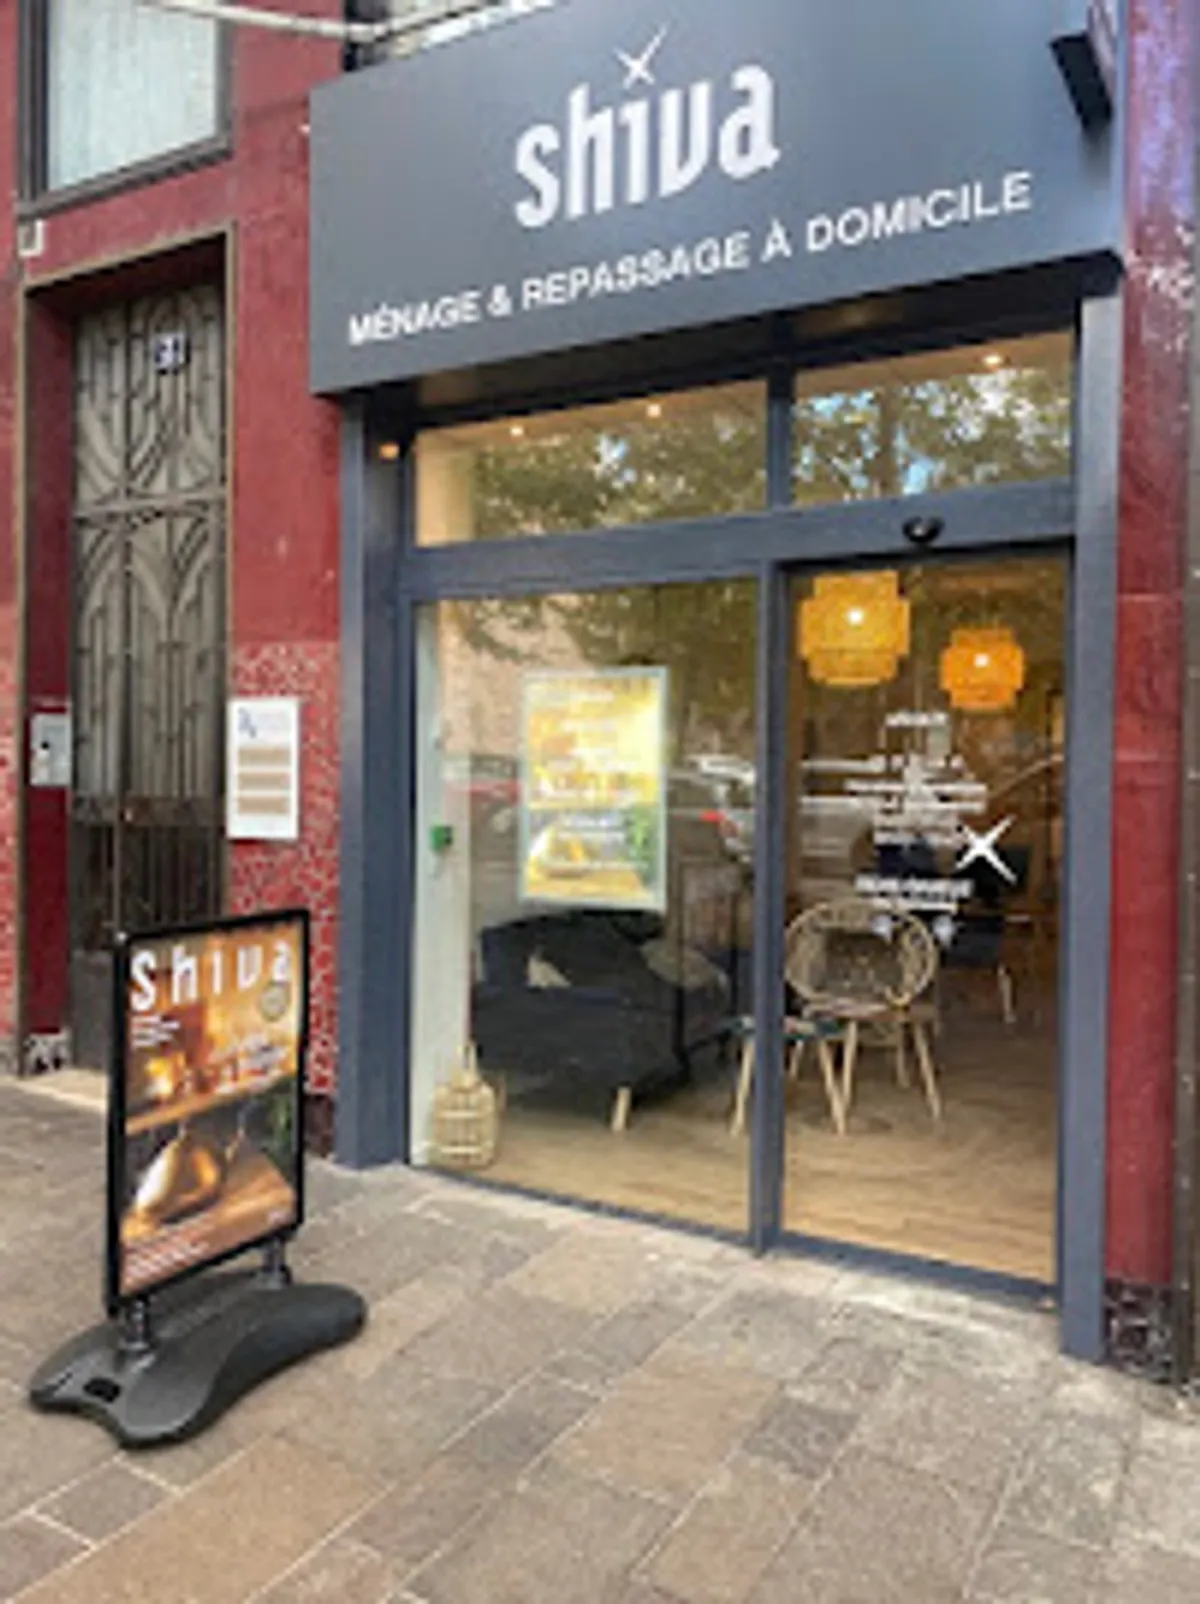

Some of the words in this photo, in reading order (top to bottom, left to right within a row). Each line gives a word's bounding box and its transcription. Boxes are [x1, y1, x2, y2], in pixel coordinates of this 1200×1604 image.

[514, 28, 781, 228] shiva
[348, 290, 480, 346] MÉNAGE
[487, 284, 513, 317] &
[522, 232, 751, 311] REPASSAGE
[761, 216, 792, 263] À
[806, 171, 1032, 252] DOMICILE
